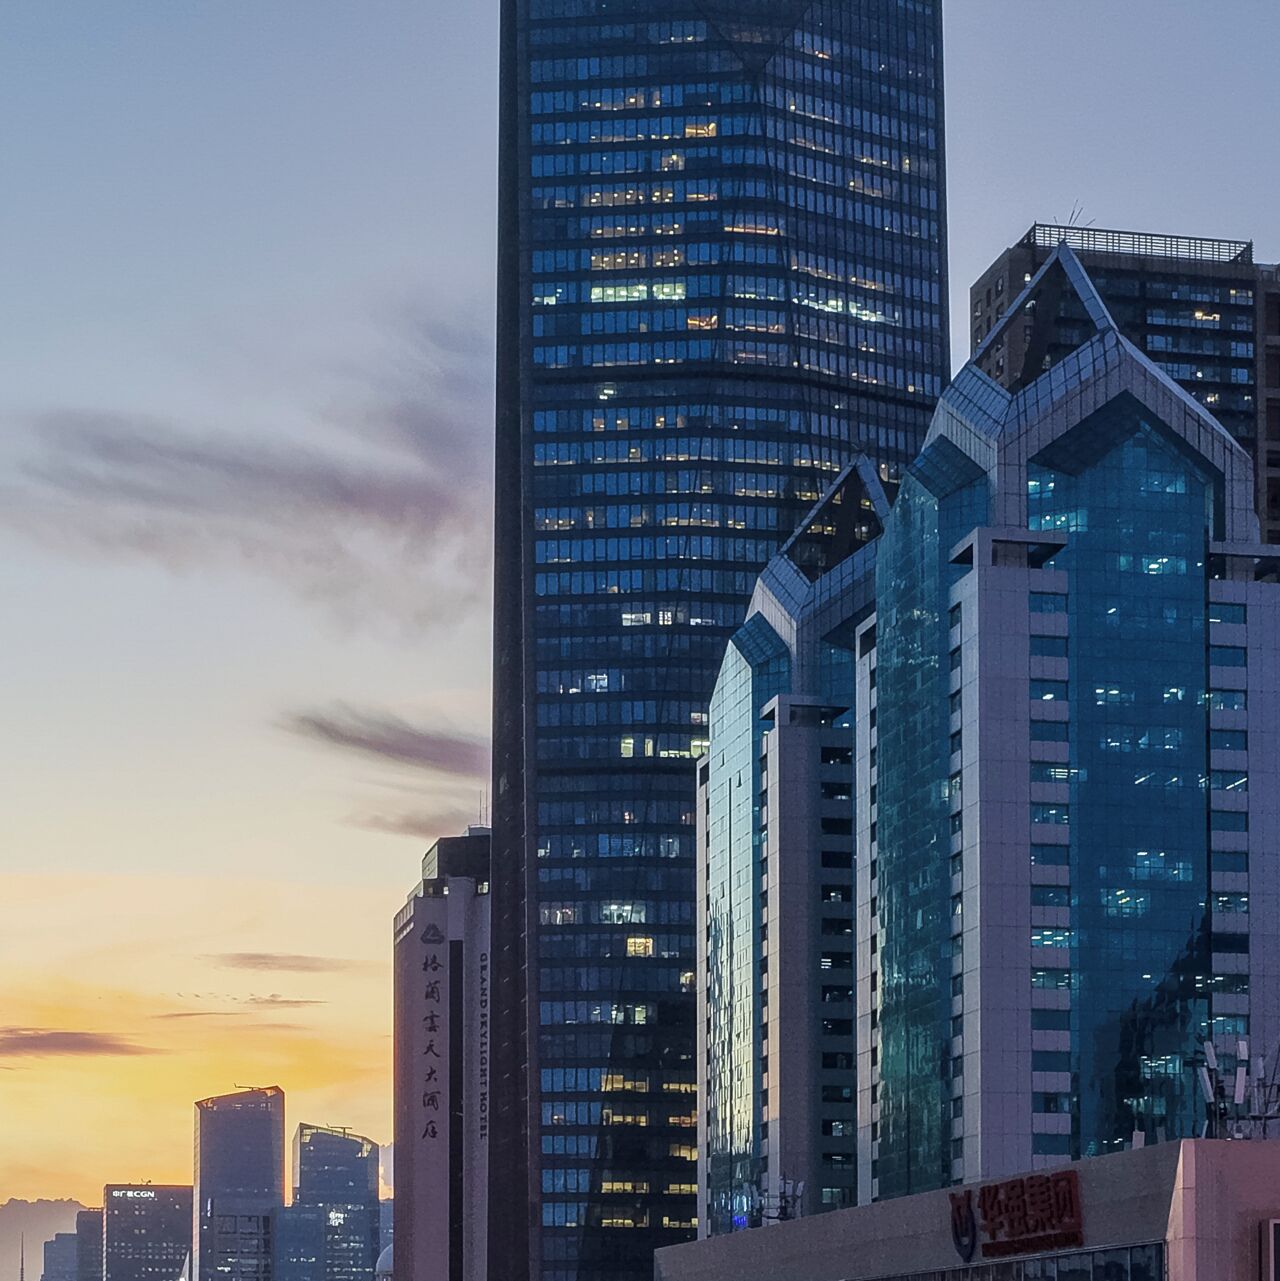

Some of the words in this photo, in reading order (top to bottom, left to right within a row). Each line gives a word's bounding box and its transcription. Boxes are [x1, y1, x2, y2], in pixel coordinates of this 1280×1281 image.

[479, 952, 488, 1009] GRAND
[479, 1013, 488, 1087] SKYLIGHT
[479, 1092, 488, 1140] HOTEL
